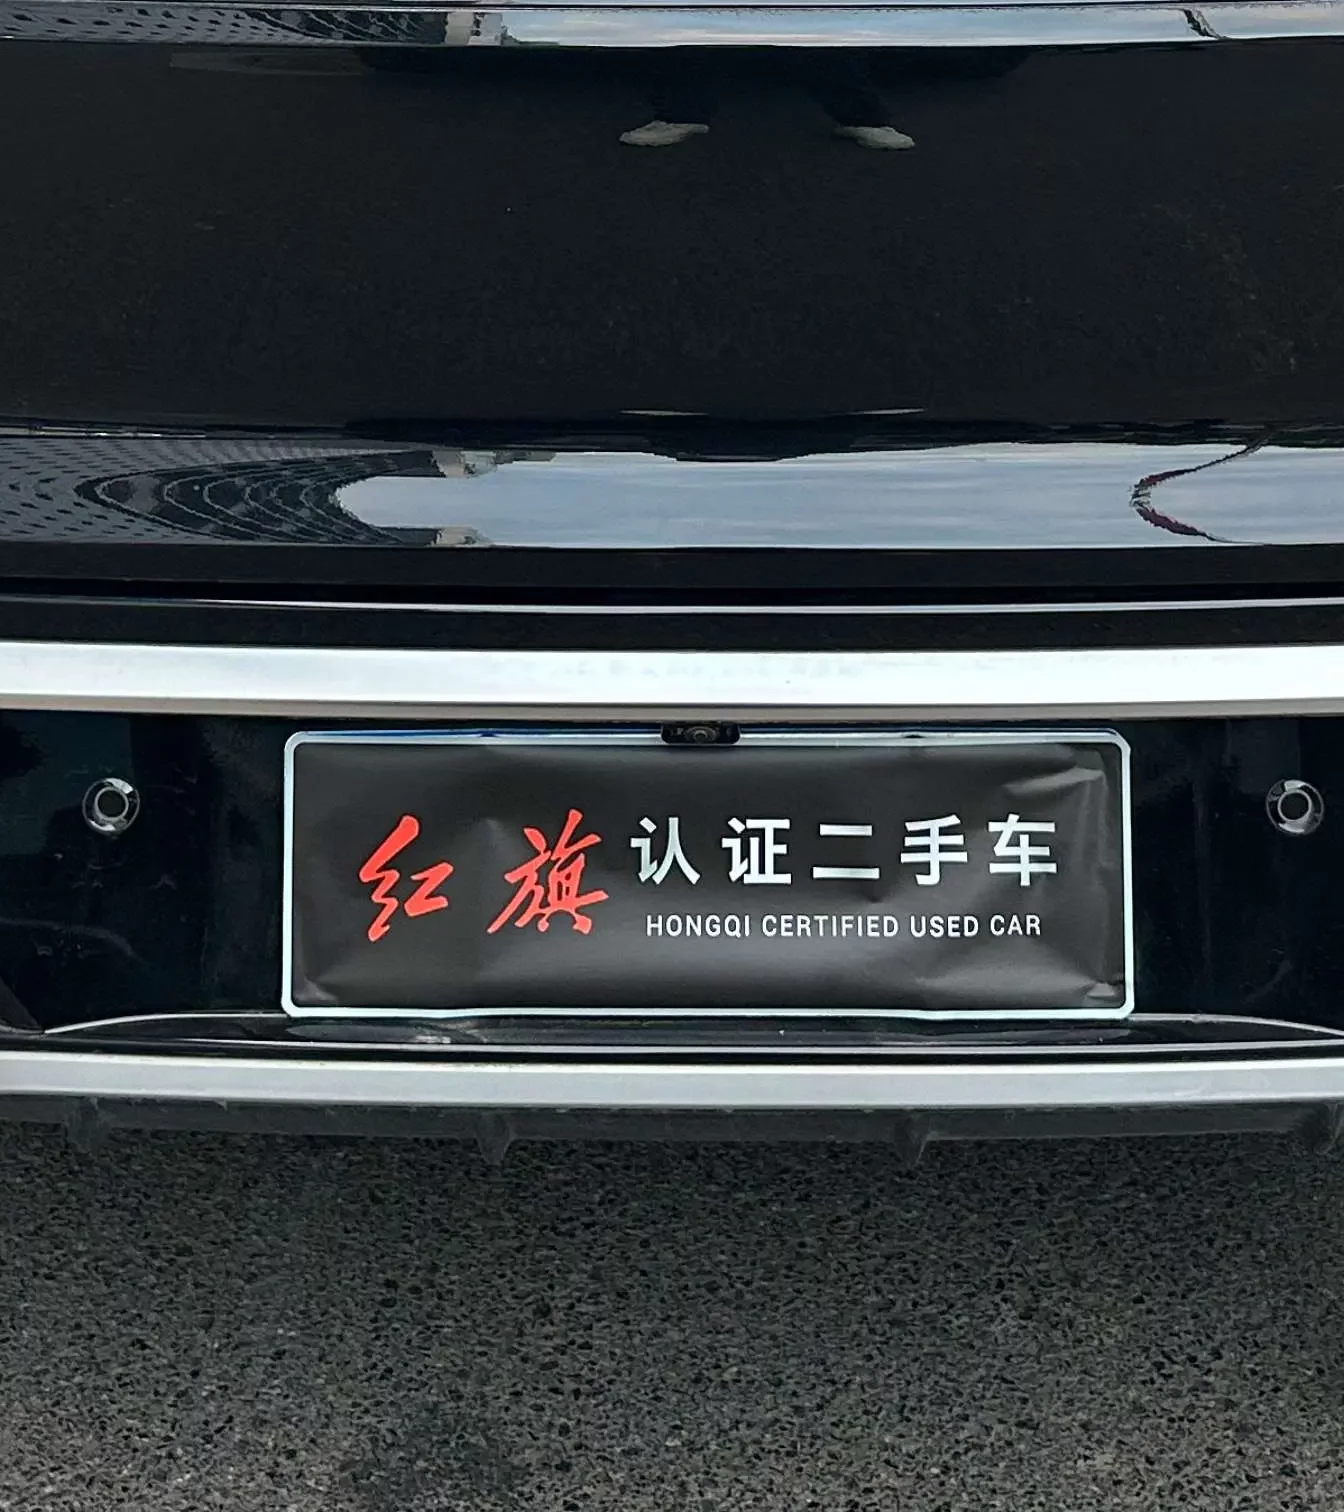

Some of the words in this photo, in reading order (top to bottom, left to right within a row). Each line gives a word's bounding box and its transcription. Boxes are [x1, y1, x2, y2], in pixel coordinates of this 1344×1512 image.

[359, 809, 609, 942] 红旗
[630, 814, 1059, 887] 认证二手车
[646, 913, 750, 938] HONGQI
[761, 913, 898, 938] CERTIFIED
[910, 913, 979, 938] USED
[989, 913, 1042, 937] CAR
